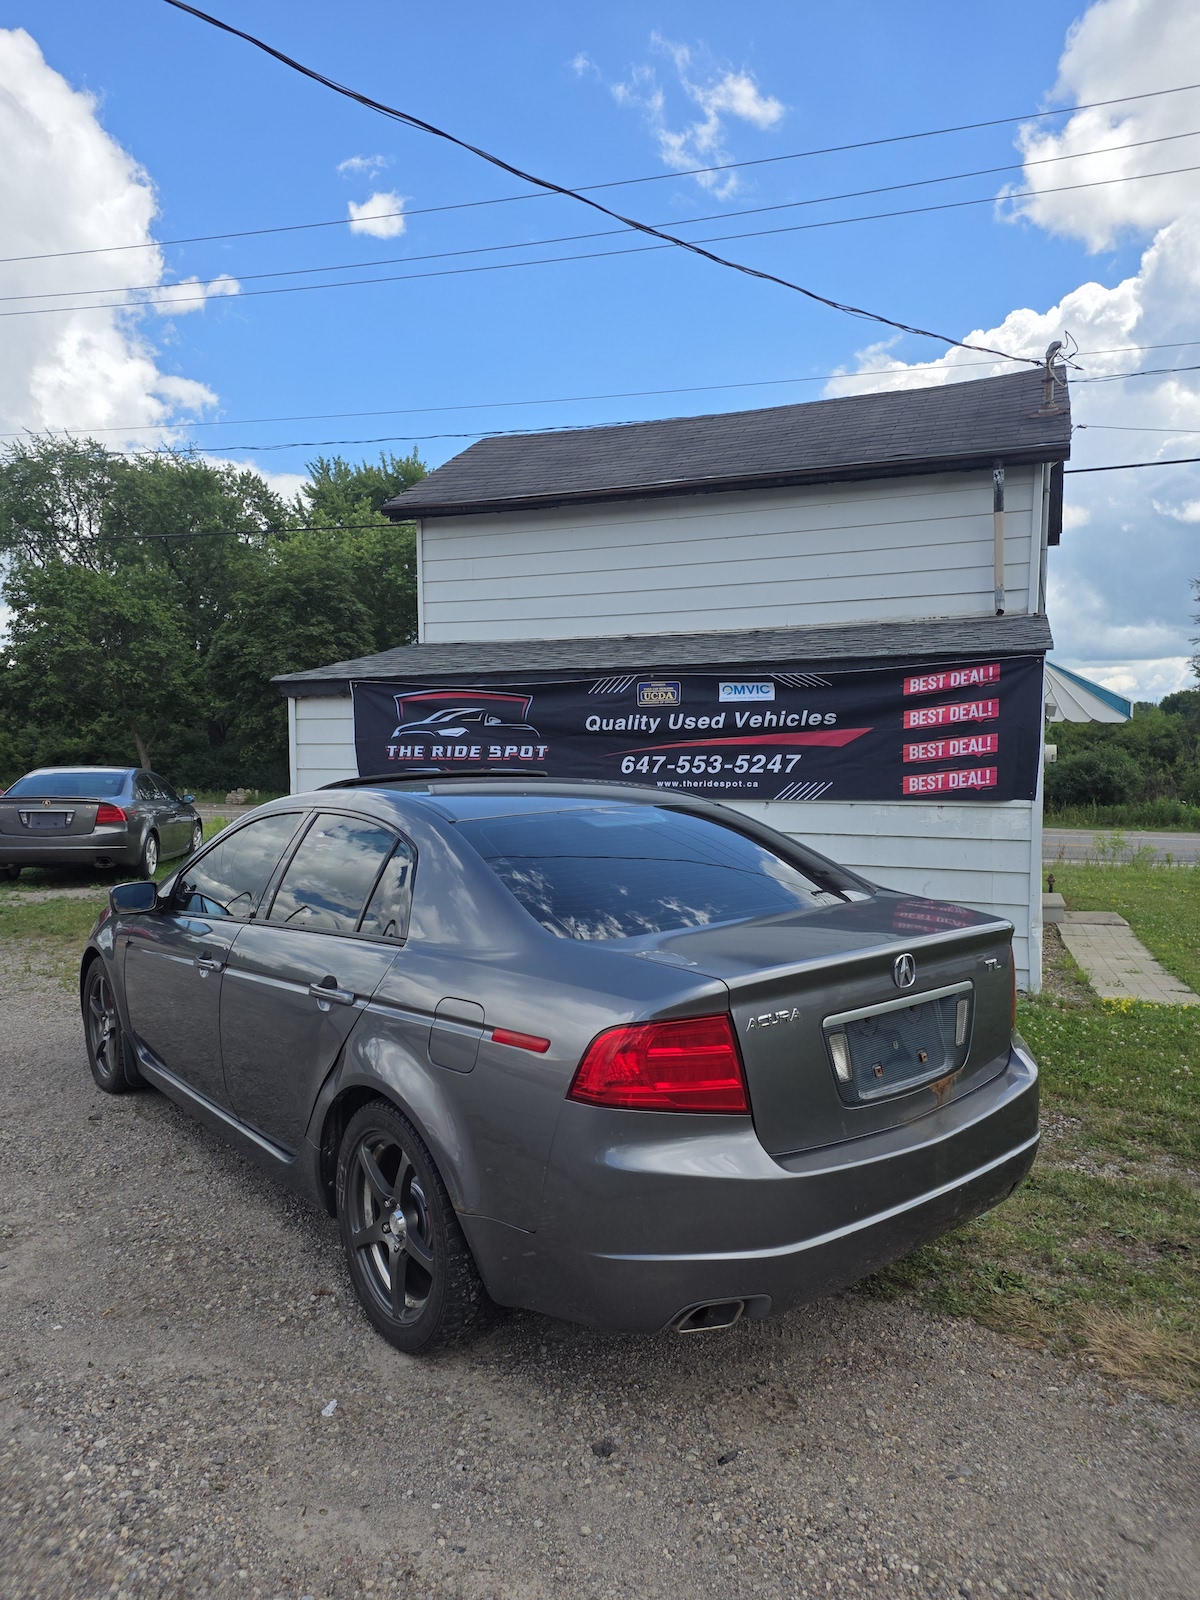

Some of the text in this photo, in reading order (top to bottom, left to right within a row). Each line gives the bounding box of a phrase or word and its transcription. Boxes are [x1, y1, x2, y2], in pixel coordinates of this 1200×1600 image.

[722, 684, 771, 695] OMVIC
[909, 666, 994, 693] BEST DEAL!
[643, 691, 674, 700] UCDA
[585, 710, 837, 733] Quality Used Vehicles
[909, 701, 992, 726] BEST DEAL!
[386, 745, 549, 760] THE RIDE SPOT
[909, 736, 991, 760] BEST DEAL!
[620, 754, 802, 774] 647-553-5247
[656, 780, 759, 789] www.theridespot.ca
[909, 769, 990, 792] BEST DEAL!
[984, 958, 1001, 971] TL
[746, 1008, 801, 1032] ACURA
